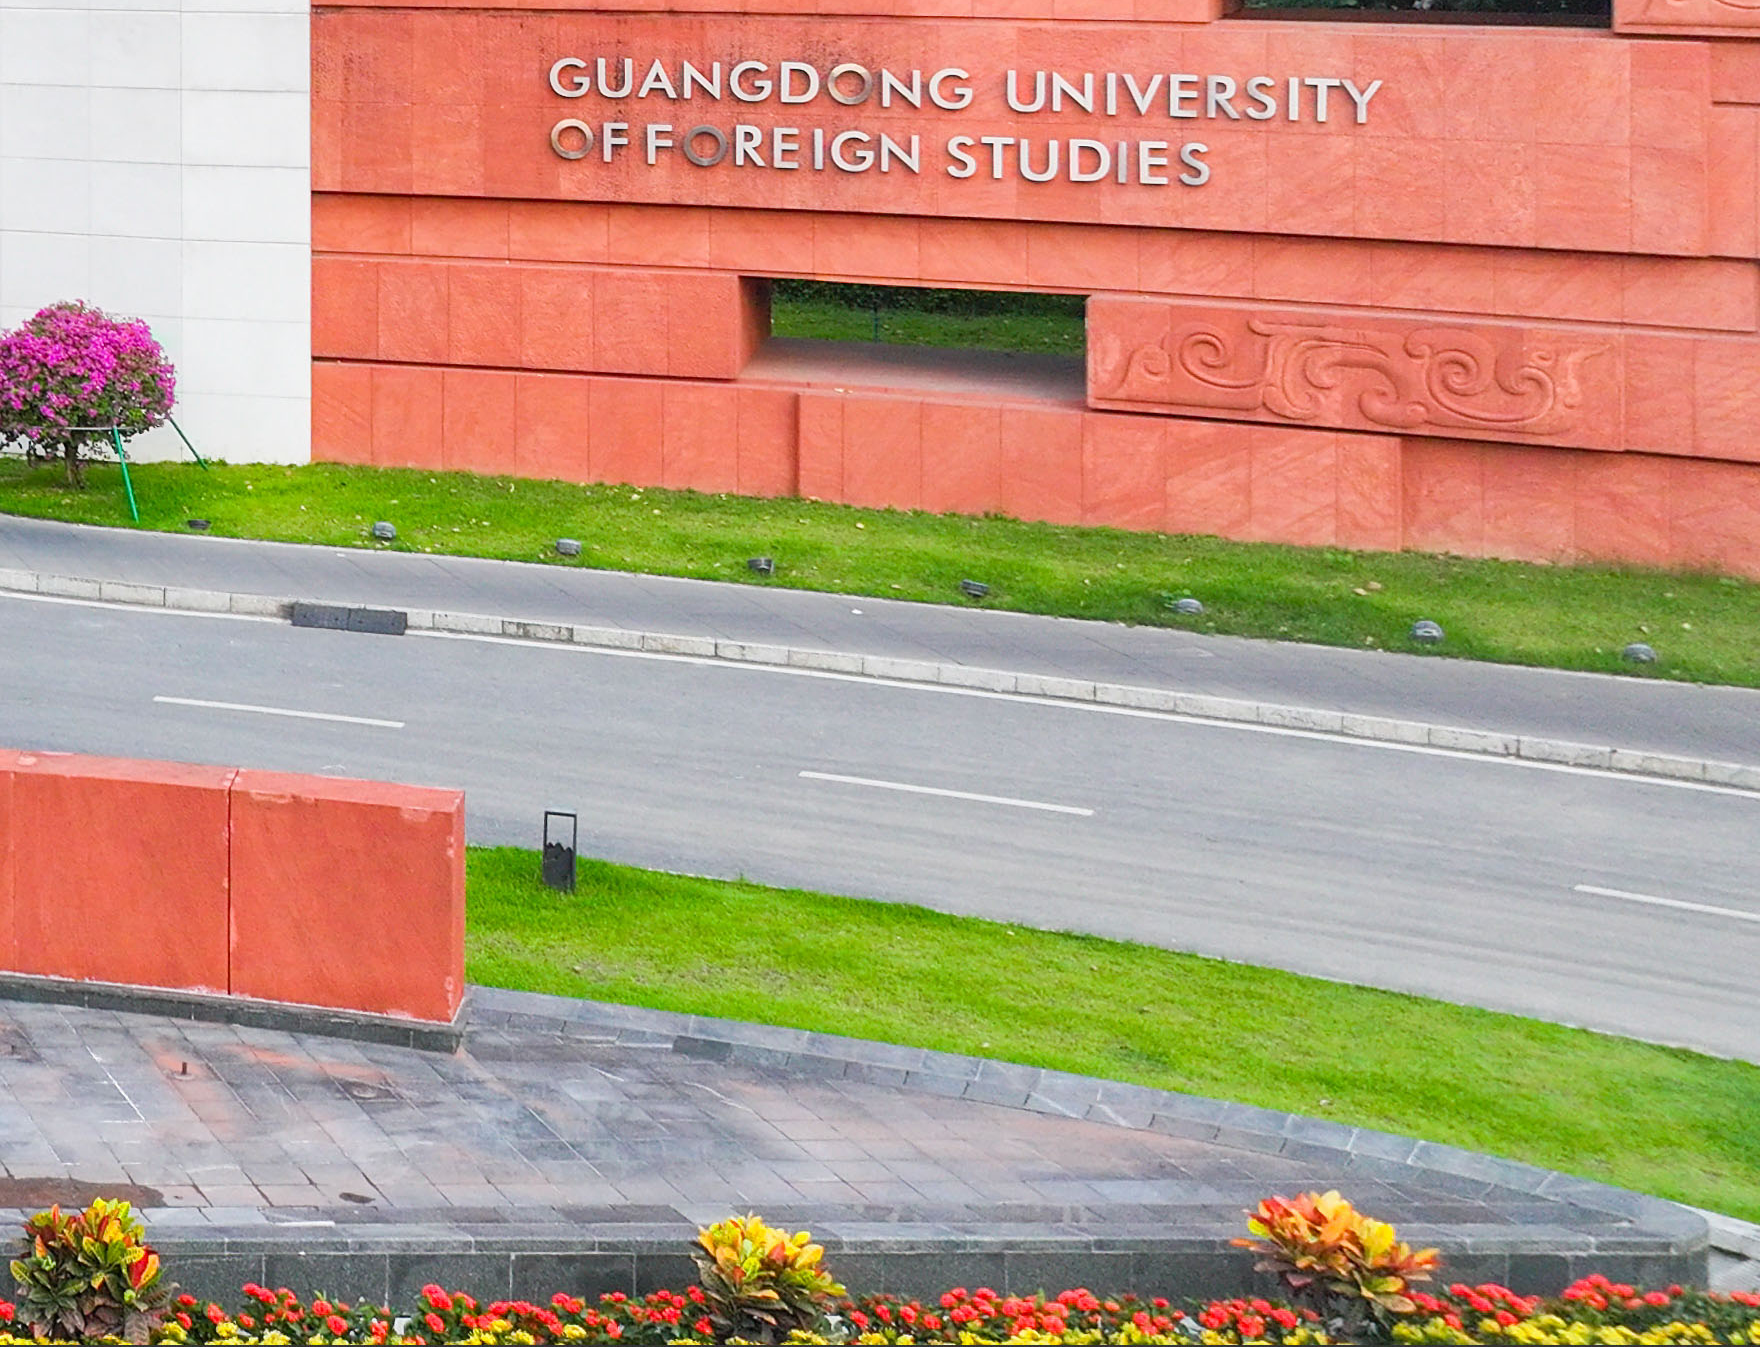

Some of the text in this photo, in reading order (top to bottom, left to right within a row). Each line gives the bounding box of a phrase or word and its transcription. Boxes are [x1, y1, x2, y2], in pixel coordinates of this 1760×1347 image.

[549, 56, 1383, 124] GUANGDONG UNIVERSITY
[946, 135, 1210, 187] STUDIES
